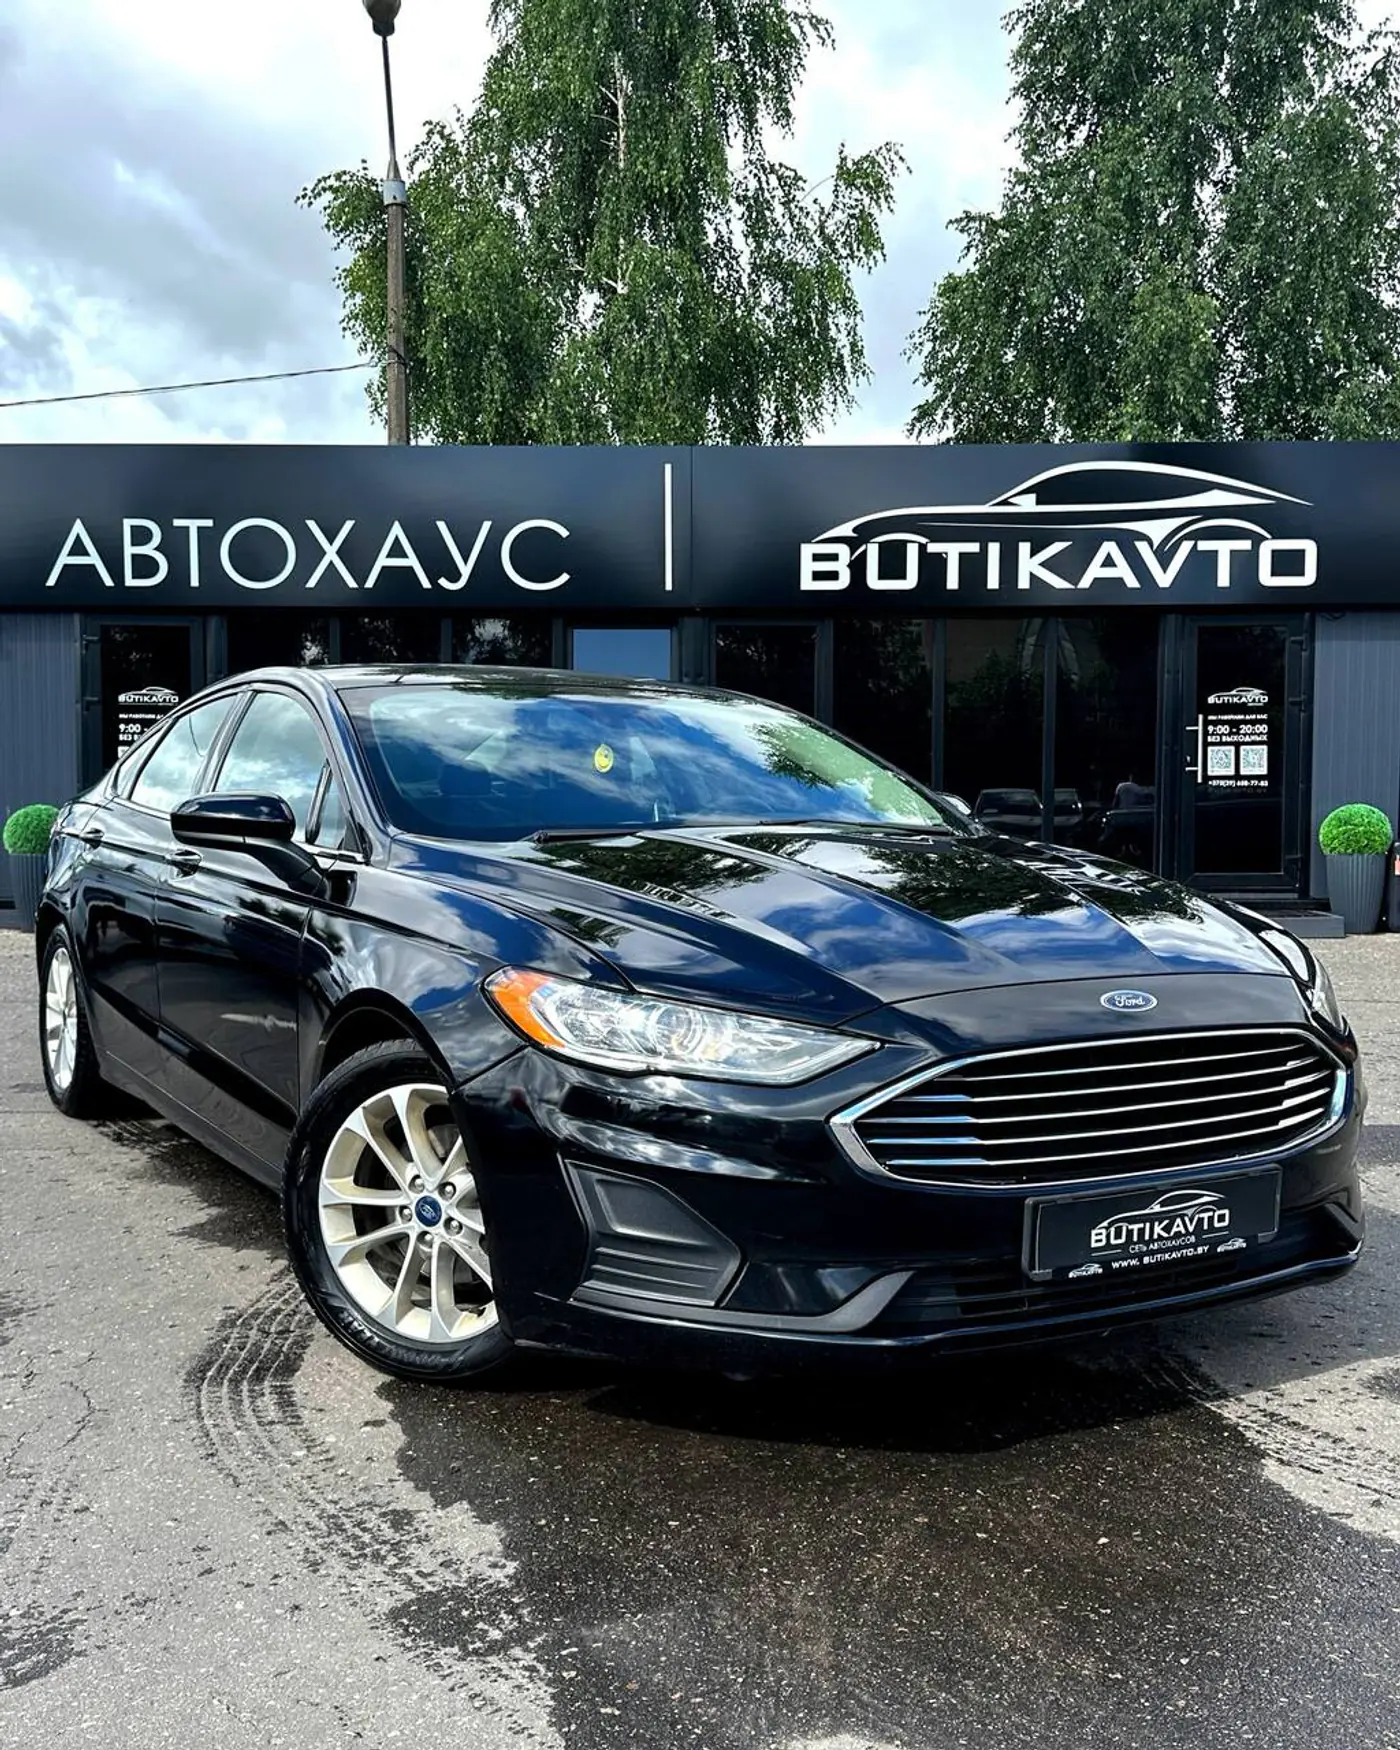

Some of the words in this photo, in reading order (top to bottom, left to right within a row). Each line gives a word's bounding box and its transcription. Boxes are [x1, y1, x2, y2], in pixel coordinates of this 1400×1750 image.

[45, 517, 571, 591] АВТОХАУС
[799, 538, 1318, 591] BUTIKAVTO
[1207, 695, 1269, 704] BUTIKAVTO
[119, 723, 141, 733] 9:00
[1207, 724, 1230, 734] 9:00
[1239, 724, 1268, 734] 20:00
[1222, 734, 1268, 743] ВЫХОДНЫХ
[1114, 994, 1146, 1008] Ford
[1090, 1208, 1230, 1248] BUTIKAVTO
[1143, 1245, 1209, 1265] BUTIKAVTO.BY
